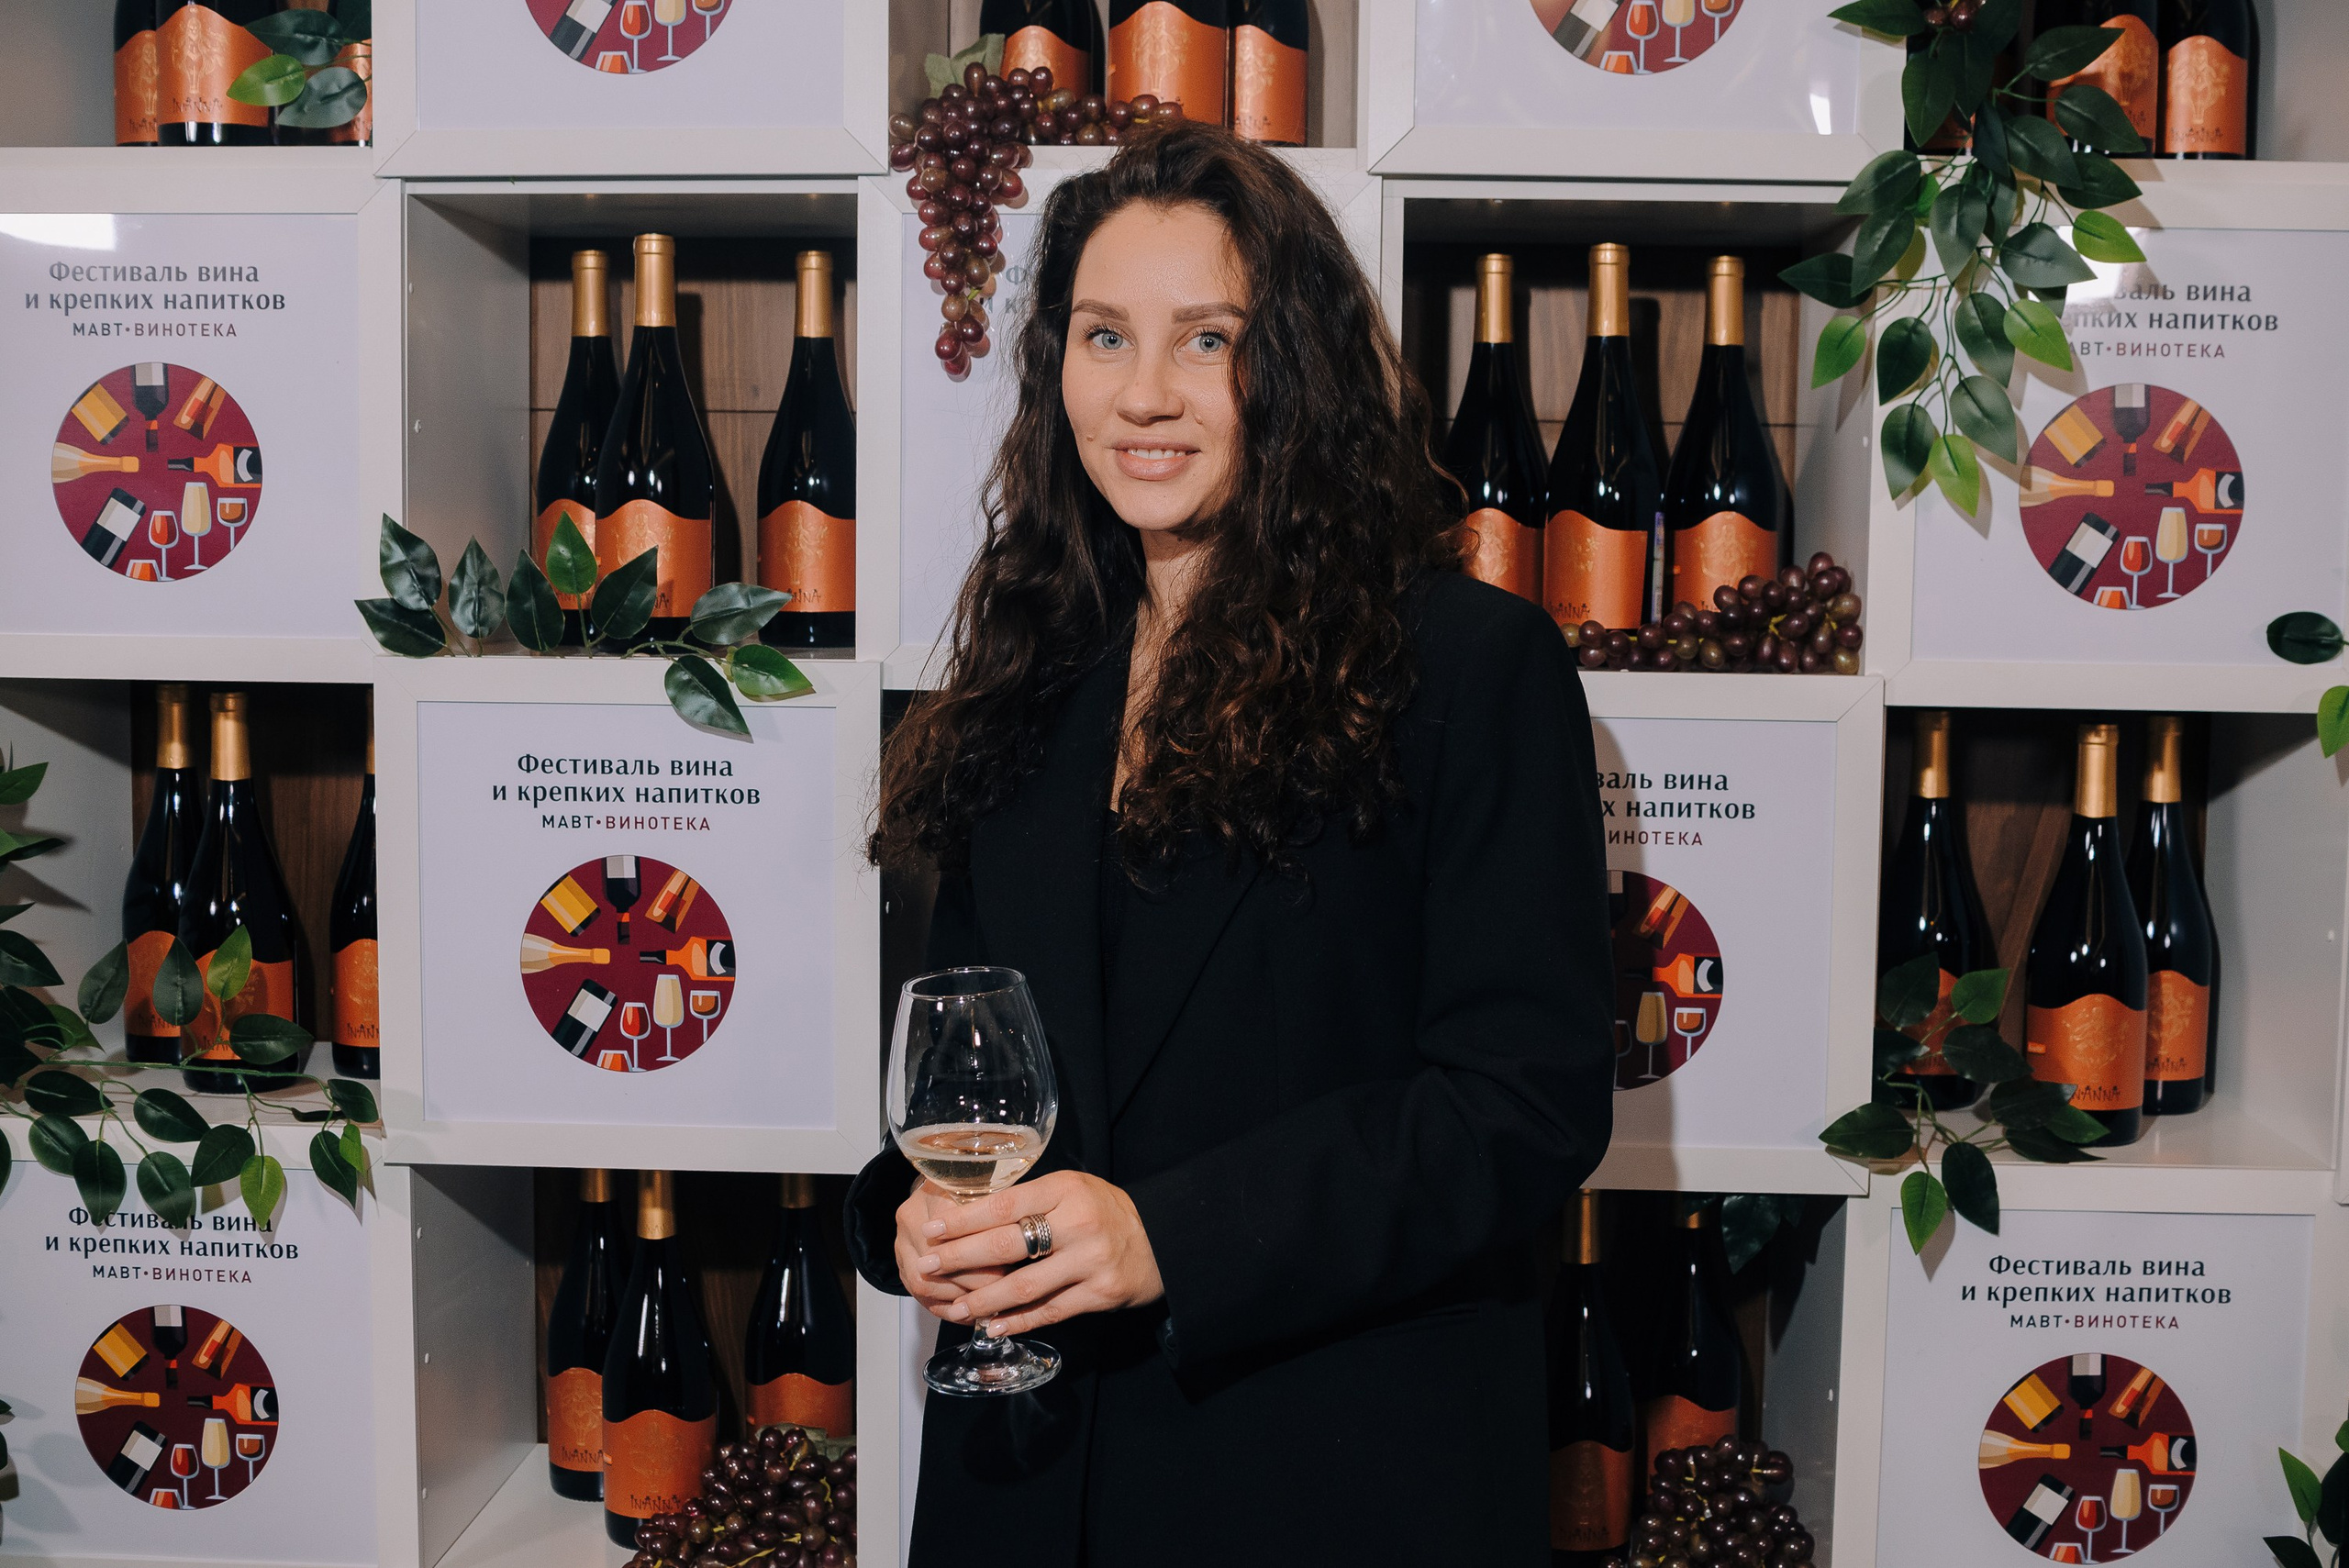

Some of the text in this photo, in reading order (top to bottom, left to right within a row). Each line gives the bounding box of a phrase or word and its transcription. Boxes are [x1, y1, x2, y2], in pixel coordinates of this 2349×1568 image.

[49, 261, 260, 283] Фестиваль вина
[2187, 284, 2252, 303] вина
[25, 293, 285, 317] и крепких напитков
[2148, 312, 2279, 331] напитков
[518, 753, 734, 777] Фестиваль вина
[1664, 773, 1729, 791] вина
[492, 784, 761, 808] и крепких напитков
[1626, 800, 1755, 819] напитков
[45, 1235, 298, 1260] и крепких напитков
[1988, 1255, 2206, 1277] Фестиваль вина
[1961, 1285, 2232, 1309] и крепких напитков
